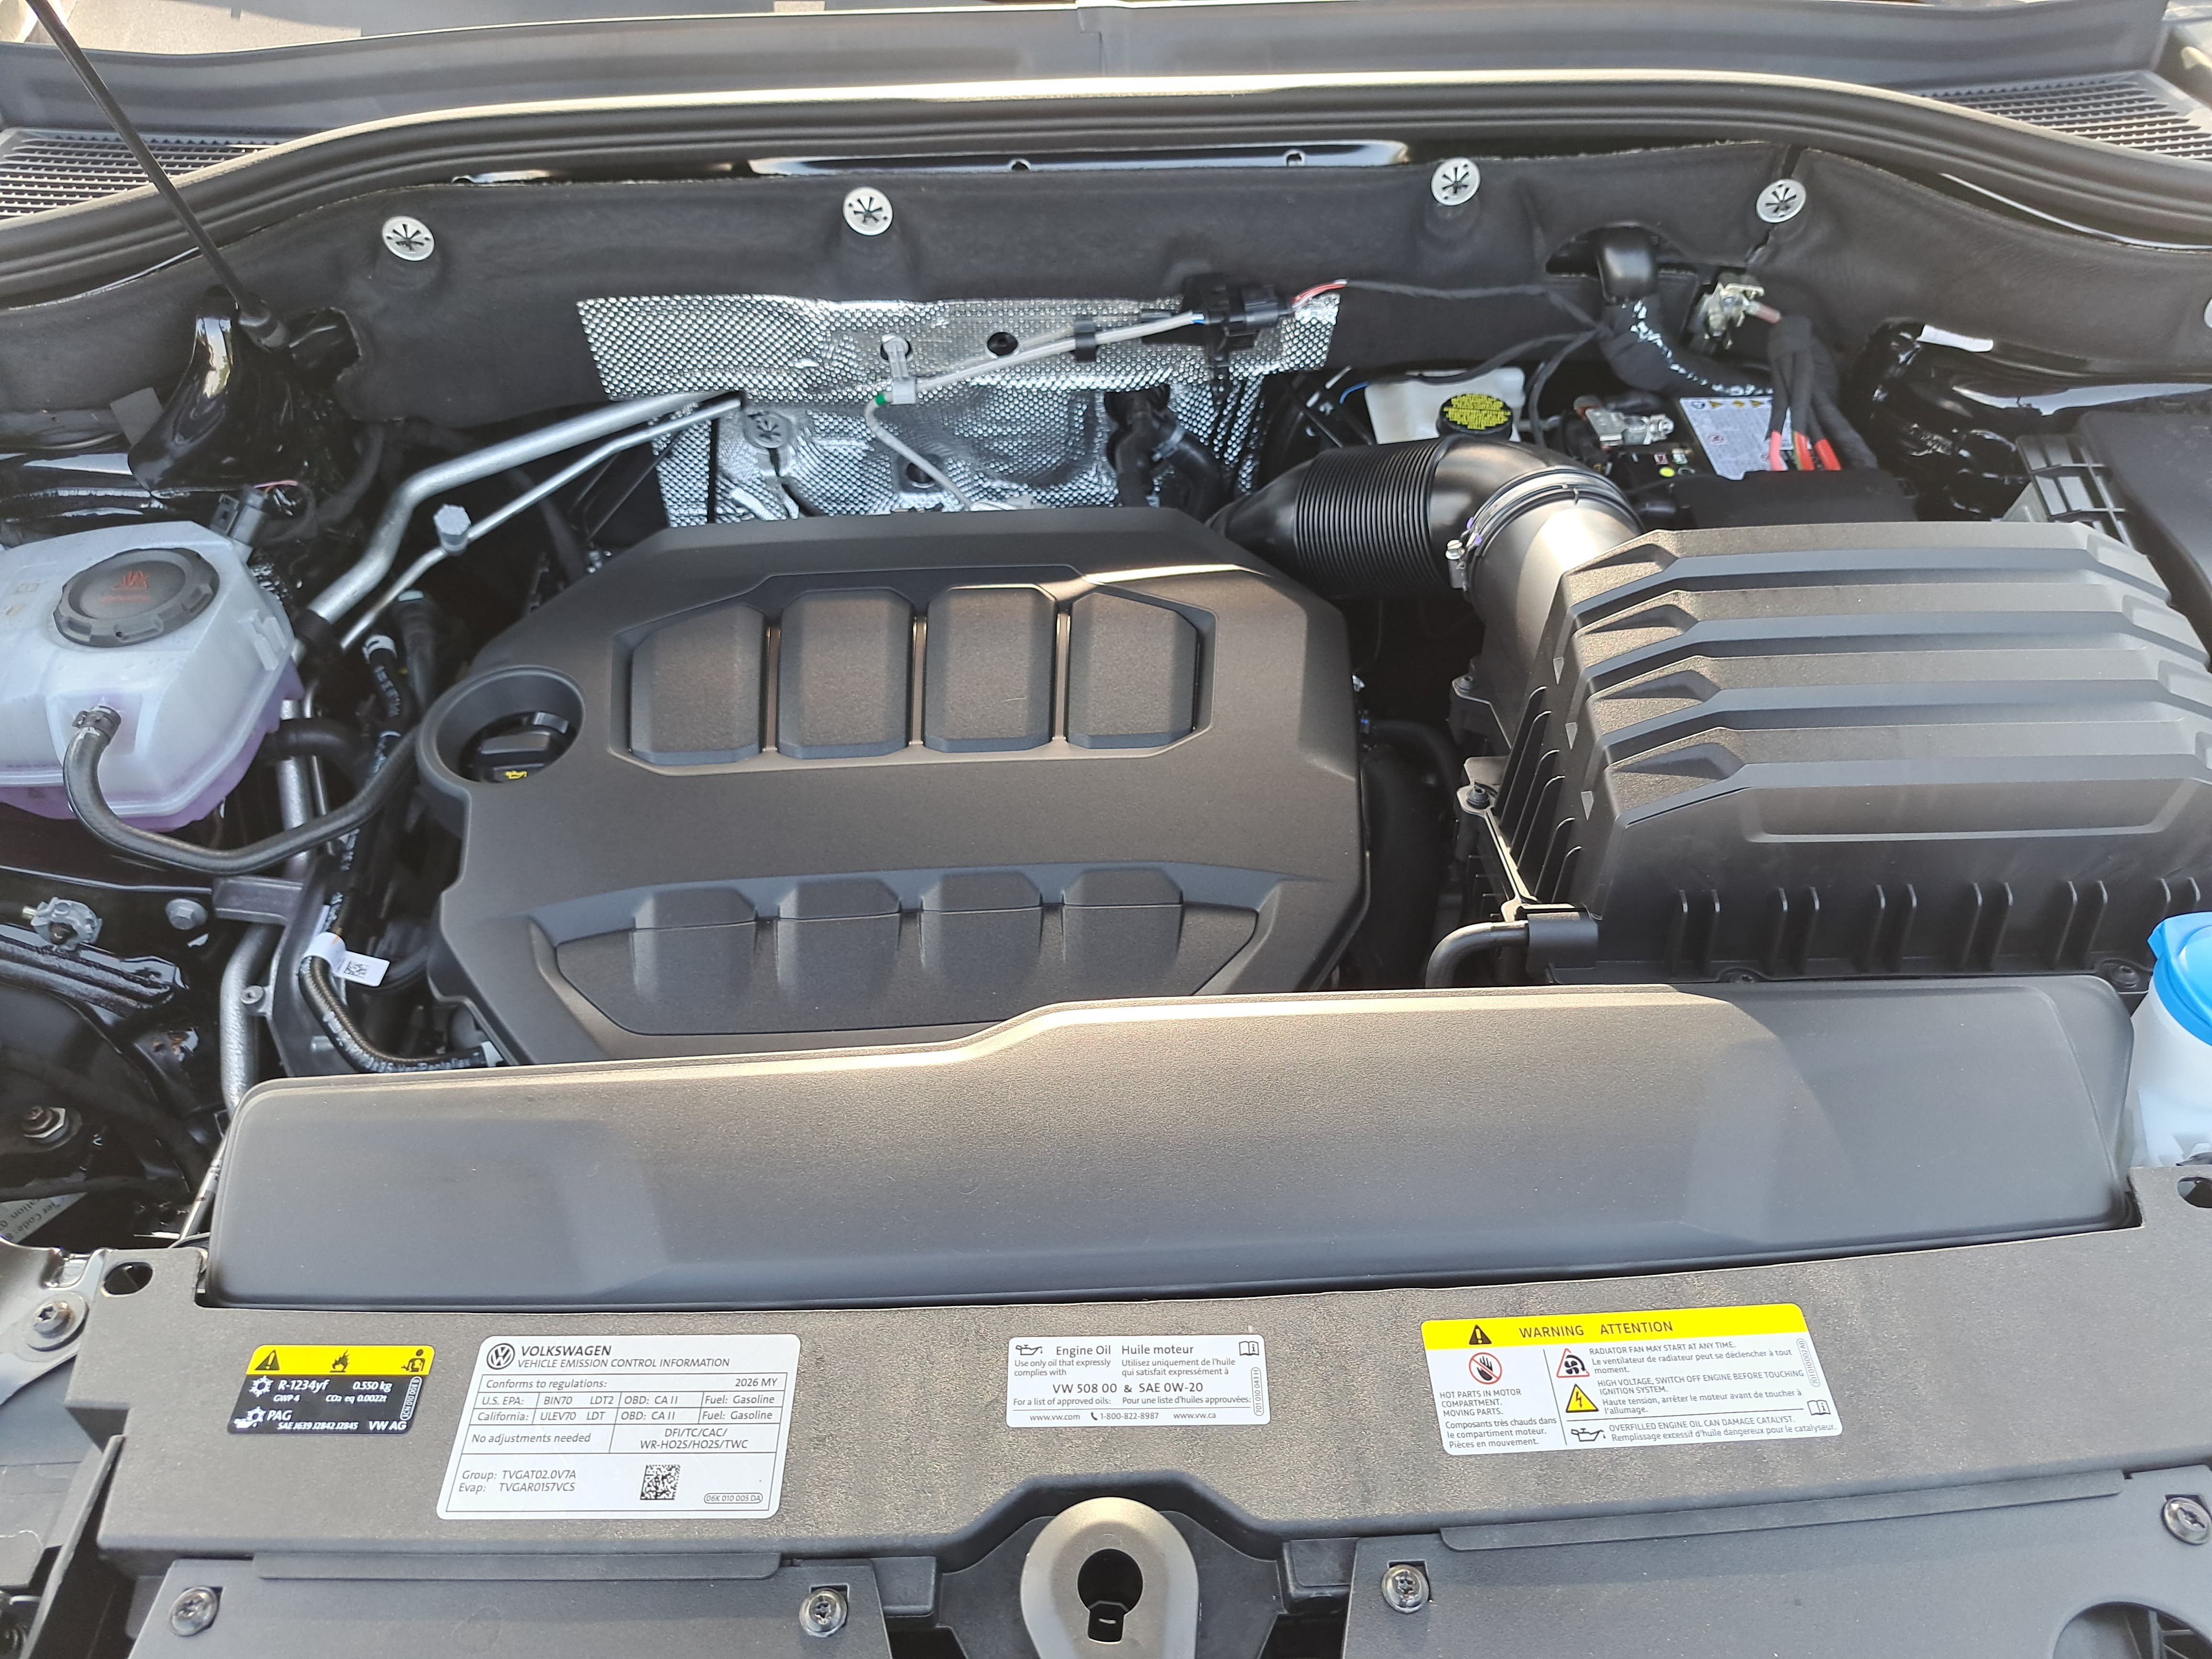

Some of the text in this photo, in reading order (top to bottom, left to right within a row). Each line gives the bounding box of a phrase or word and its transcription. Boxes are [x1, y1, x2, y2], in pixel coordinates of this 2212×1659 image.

[1519, 1325, 1584, 1338] WARNING
[1601, 1321, 1673, 1335] ATTENTION
[521, 1346, 611, 1356] VOLKSWAGEN
[1056, 1345, 1111, 1358] Engine Oil
[1122, 1345, 1194, 1354] Huile moteur
[518, 1358, 730, 1368] VEHICLE EMISSION CONTROL INFORMATION
[1030, 1360, 1046, 1368] only
[1076, 1359, 1111, 1367] expressly
[1152, 1359, 1199, 1368] uniquement
[1603, 1357, 1644, 1365] ventilateur
[1659, 1354, 1693, 1362] radiateur
[1014, 1369, 1047, 1378] complies
[1169, 1368, 1222, 1377] expressément
[1764, 1370, 1804, 1378] TOUCHING
[278, 1379, 330, 1393] R-1234yf
[353, 1381, 392, 1393] 0.550 kg
[487, 1379, 607, 1390] Conforms to regulations:
[735, 1378, 778, 1386] 2026 MY
[1053, 1382, 1203, 1393] VW 508 00 & SAE 0W-20
[344, 1395, 355, 1404] eq
[502, 1396, 524, 1405] EPA:
[544, 1396, 614, 1405] BIN70 LDT2
[624, 1396, 649, 1404] OBD:
[705, 1395, 775, 1404] Fuel: Gasoline
[1057, 1397, 1093, 1407] approved
[1205, 1396, 1251, 1405] approuvées:
[1441, 1399, 1503, 1407] COMPARTMENT.
[1662, 1395, 1688, 1403] arrêter
[266, 1410, 292, 1420] PAG
[477, 1411, 529, 1421] California:
[540, 1412, 605, 1420] ULEV70 LDT
[621, 1411, 646, 1420] OBD:
[702, 1411, 772, 1419] Fuel: Gasoline
[369, 1421, 407, 1430] VW AG
[1446, 1421, 1493, 1429] Composants
[1510, 1417, 1537, 1426] chauds
[1609, 1423, 1656, 1431] OVERFILLED
[1722, 1417, 1755, 1426] DAMAGE
[664, 1428, 728, 1437] DFI/TC/CAC/
[1457, 1429, 1513, 1439] compartiment
[1612, 1433, 1660, 1442] Remplissage
[1795, 1424, 1837, 1433] catalyseur.
[472, 1433, 591, 1445] No adjustments needed
[640, 1439, 748, 1449] WR-HO2S/HO2S/TWC
[462, 1471, 497, 1481] Group:
[459, 1483, 486, 1494] Evap:
